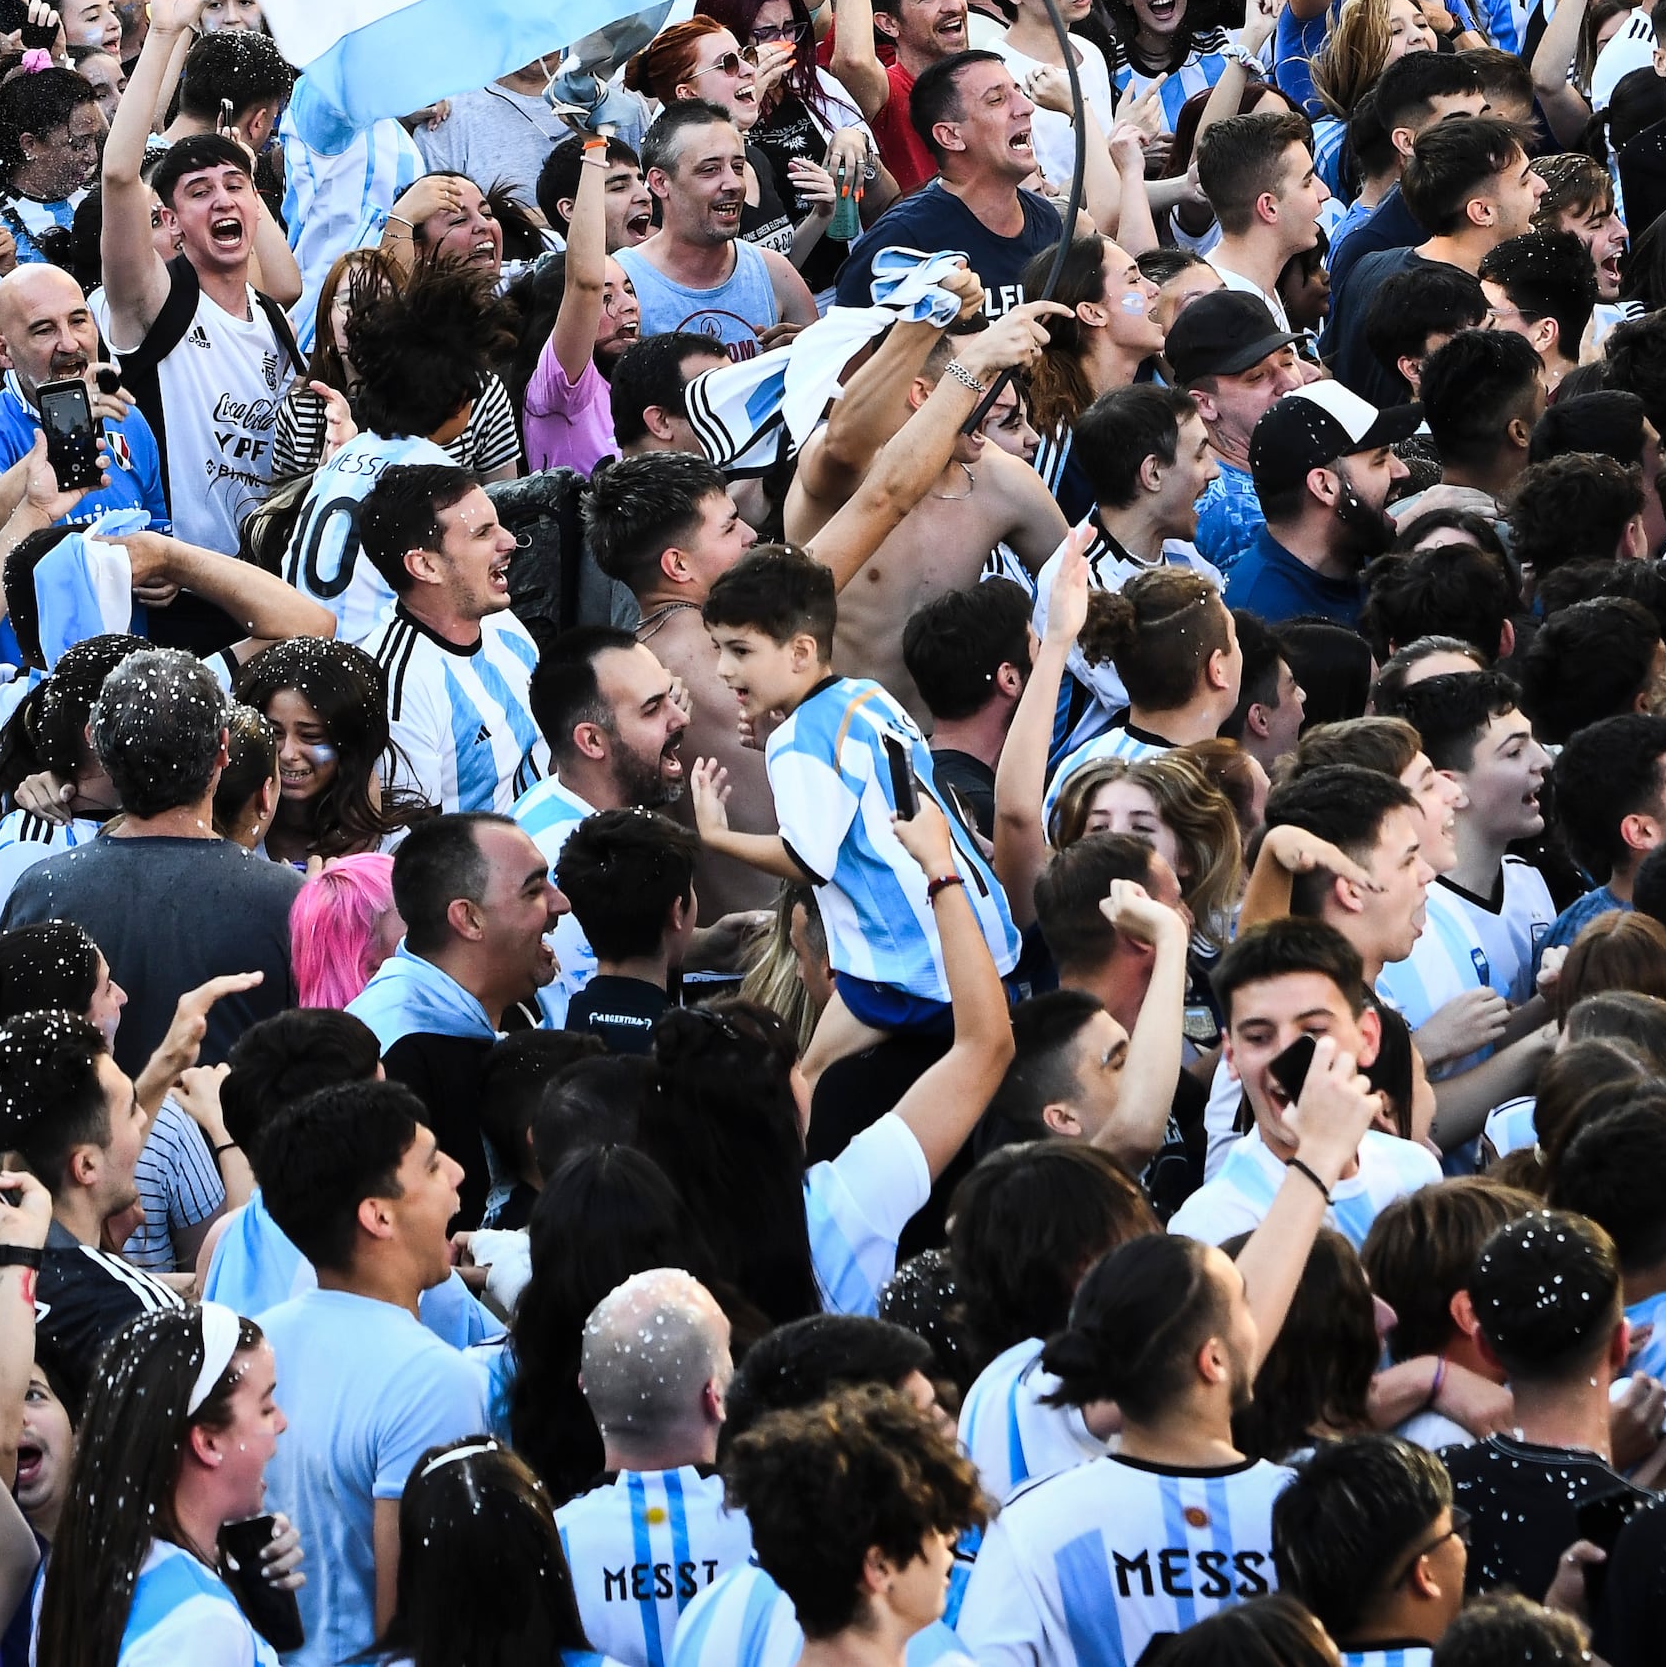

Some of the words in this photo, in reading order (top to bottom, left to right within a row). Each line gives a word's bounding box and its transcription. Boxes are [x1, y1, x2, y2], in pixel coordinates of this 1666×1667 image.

[214, 430, 269, 464] YPF
[285, 495, 362, 602] 10
[603, 1559, 719, 1602] MESSI
[1112, 1549, 1280, 1601] MESS
